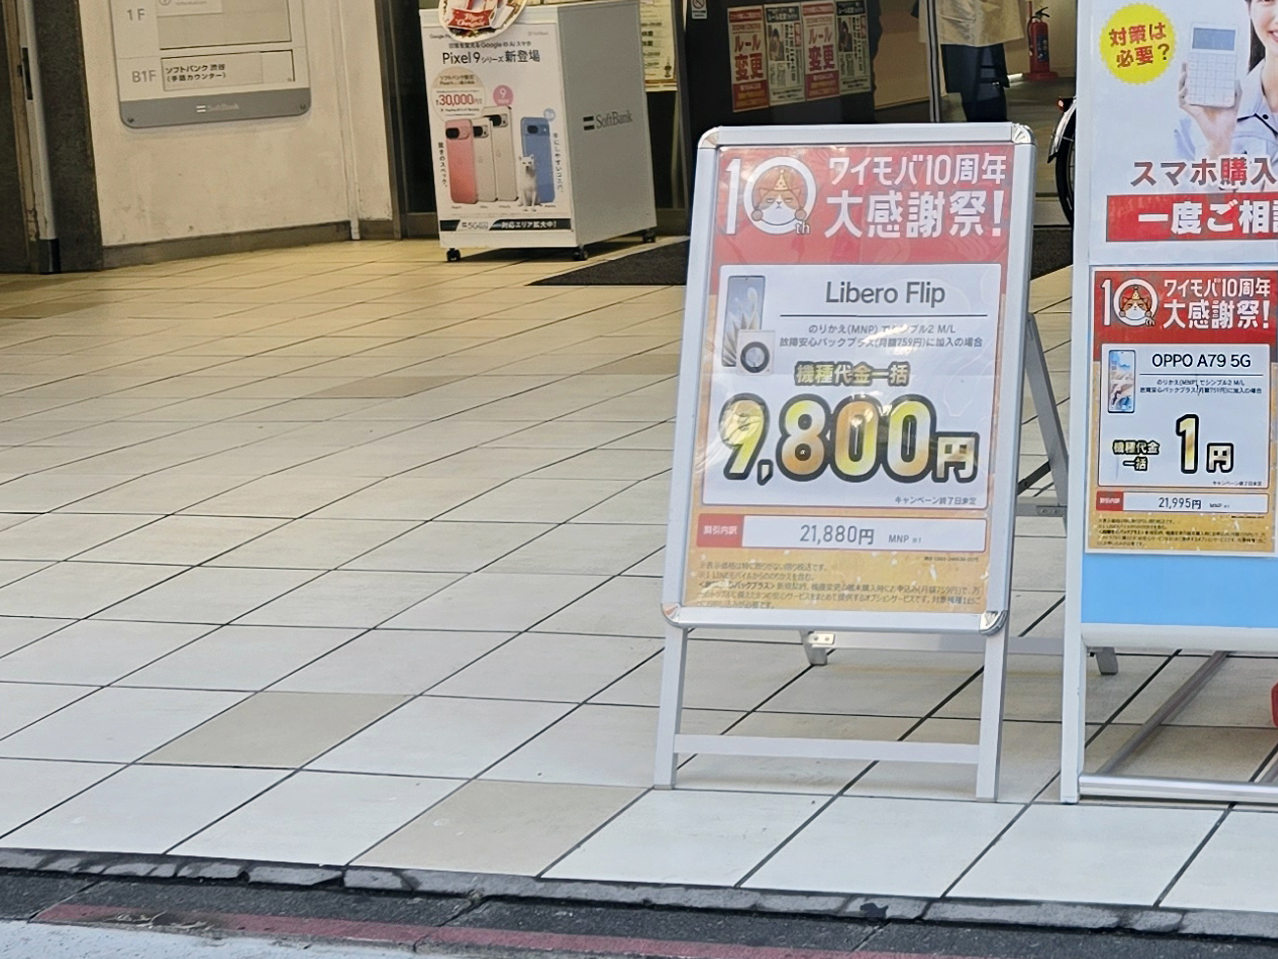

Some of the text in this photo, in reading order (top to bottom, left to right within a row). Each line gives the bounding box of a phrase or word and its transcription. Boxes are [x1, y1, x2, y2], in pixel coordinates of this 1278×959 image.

[126, 8, 146, 21] 1F
[1108, 21, 1167, 47] 対策は
[442, 52, 472, 64] Pixel
[734, 52, 764, 81] 変更
[808, 44, 835, 72] 変更
[131, 70, 157, 83] B1F
[165, 64, 208, 74] ソフトバンク
[596, 109, 633, 130] SoftBank
[828, 152, 1007, 186] ワイモバ10周年
[824, 189, 1004, 239] 大感謝祭!
[825, 281, 946, 308] Libero Flip
[1163, 277, 1271, 298] ワイモバ10周年
[1163, 299, 1270, 329] 大感謝祭!
[937, 325, 956, 334] M/L
[1151, 353, 1251, 368] OPPO A79 5G
[794, 360, 911, 387] 機種代金一括
[717, 392, 981, 486] 9,800円
[1112, 440, 1160, 455] 機種代金
[1123, 457, 1148, 472] 一括
[1158, 497, 1202, 510] 21,995円
[799, 524, 875, 546] 21,880円
[888, 534, 910, 543] MNP
